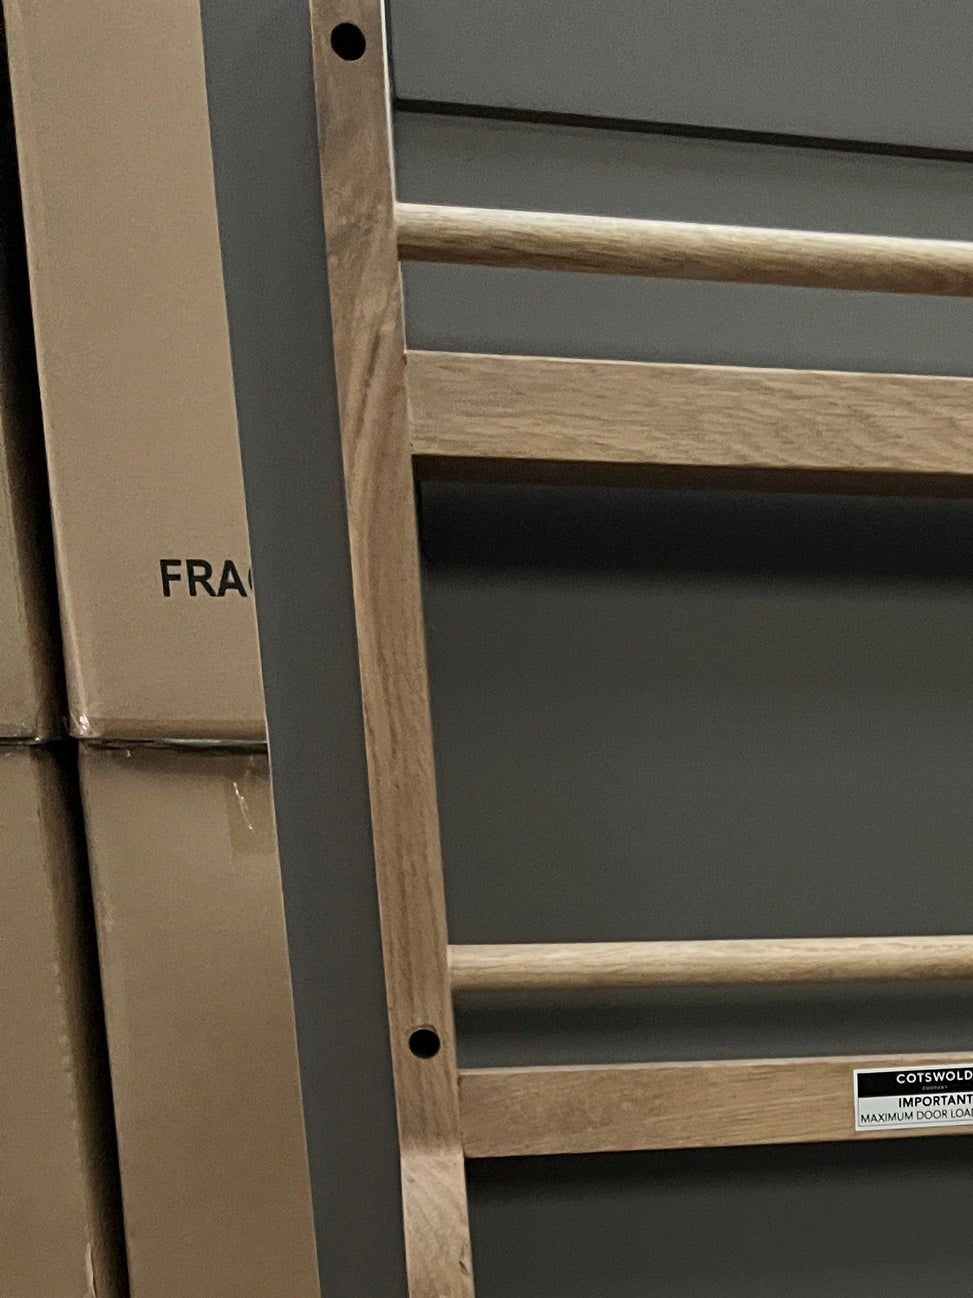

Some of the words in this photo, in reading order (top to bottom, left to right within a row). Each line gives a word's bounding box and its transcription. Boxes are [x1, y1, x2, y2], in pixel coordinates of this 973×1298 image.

[160, 559, 253, 597] FRA
[896, 1070, 973, 1084] COTSWOLD
[899, 1094, 973, 1108] IMPORTANT
[860, 1111, 914, 1123] MAXIMUM
[916, 1109, 948, 1121] DOOR
